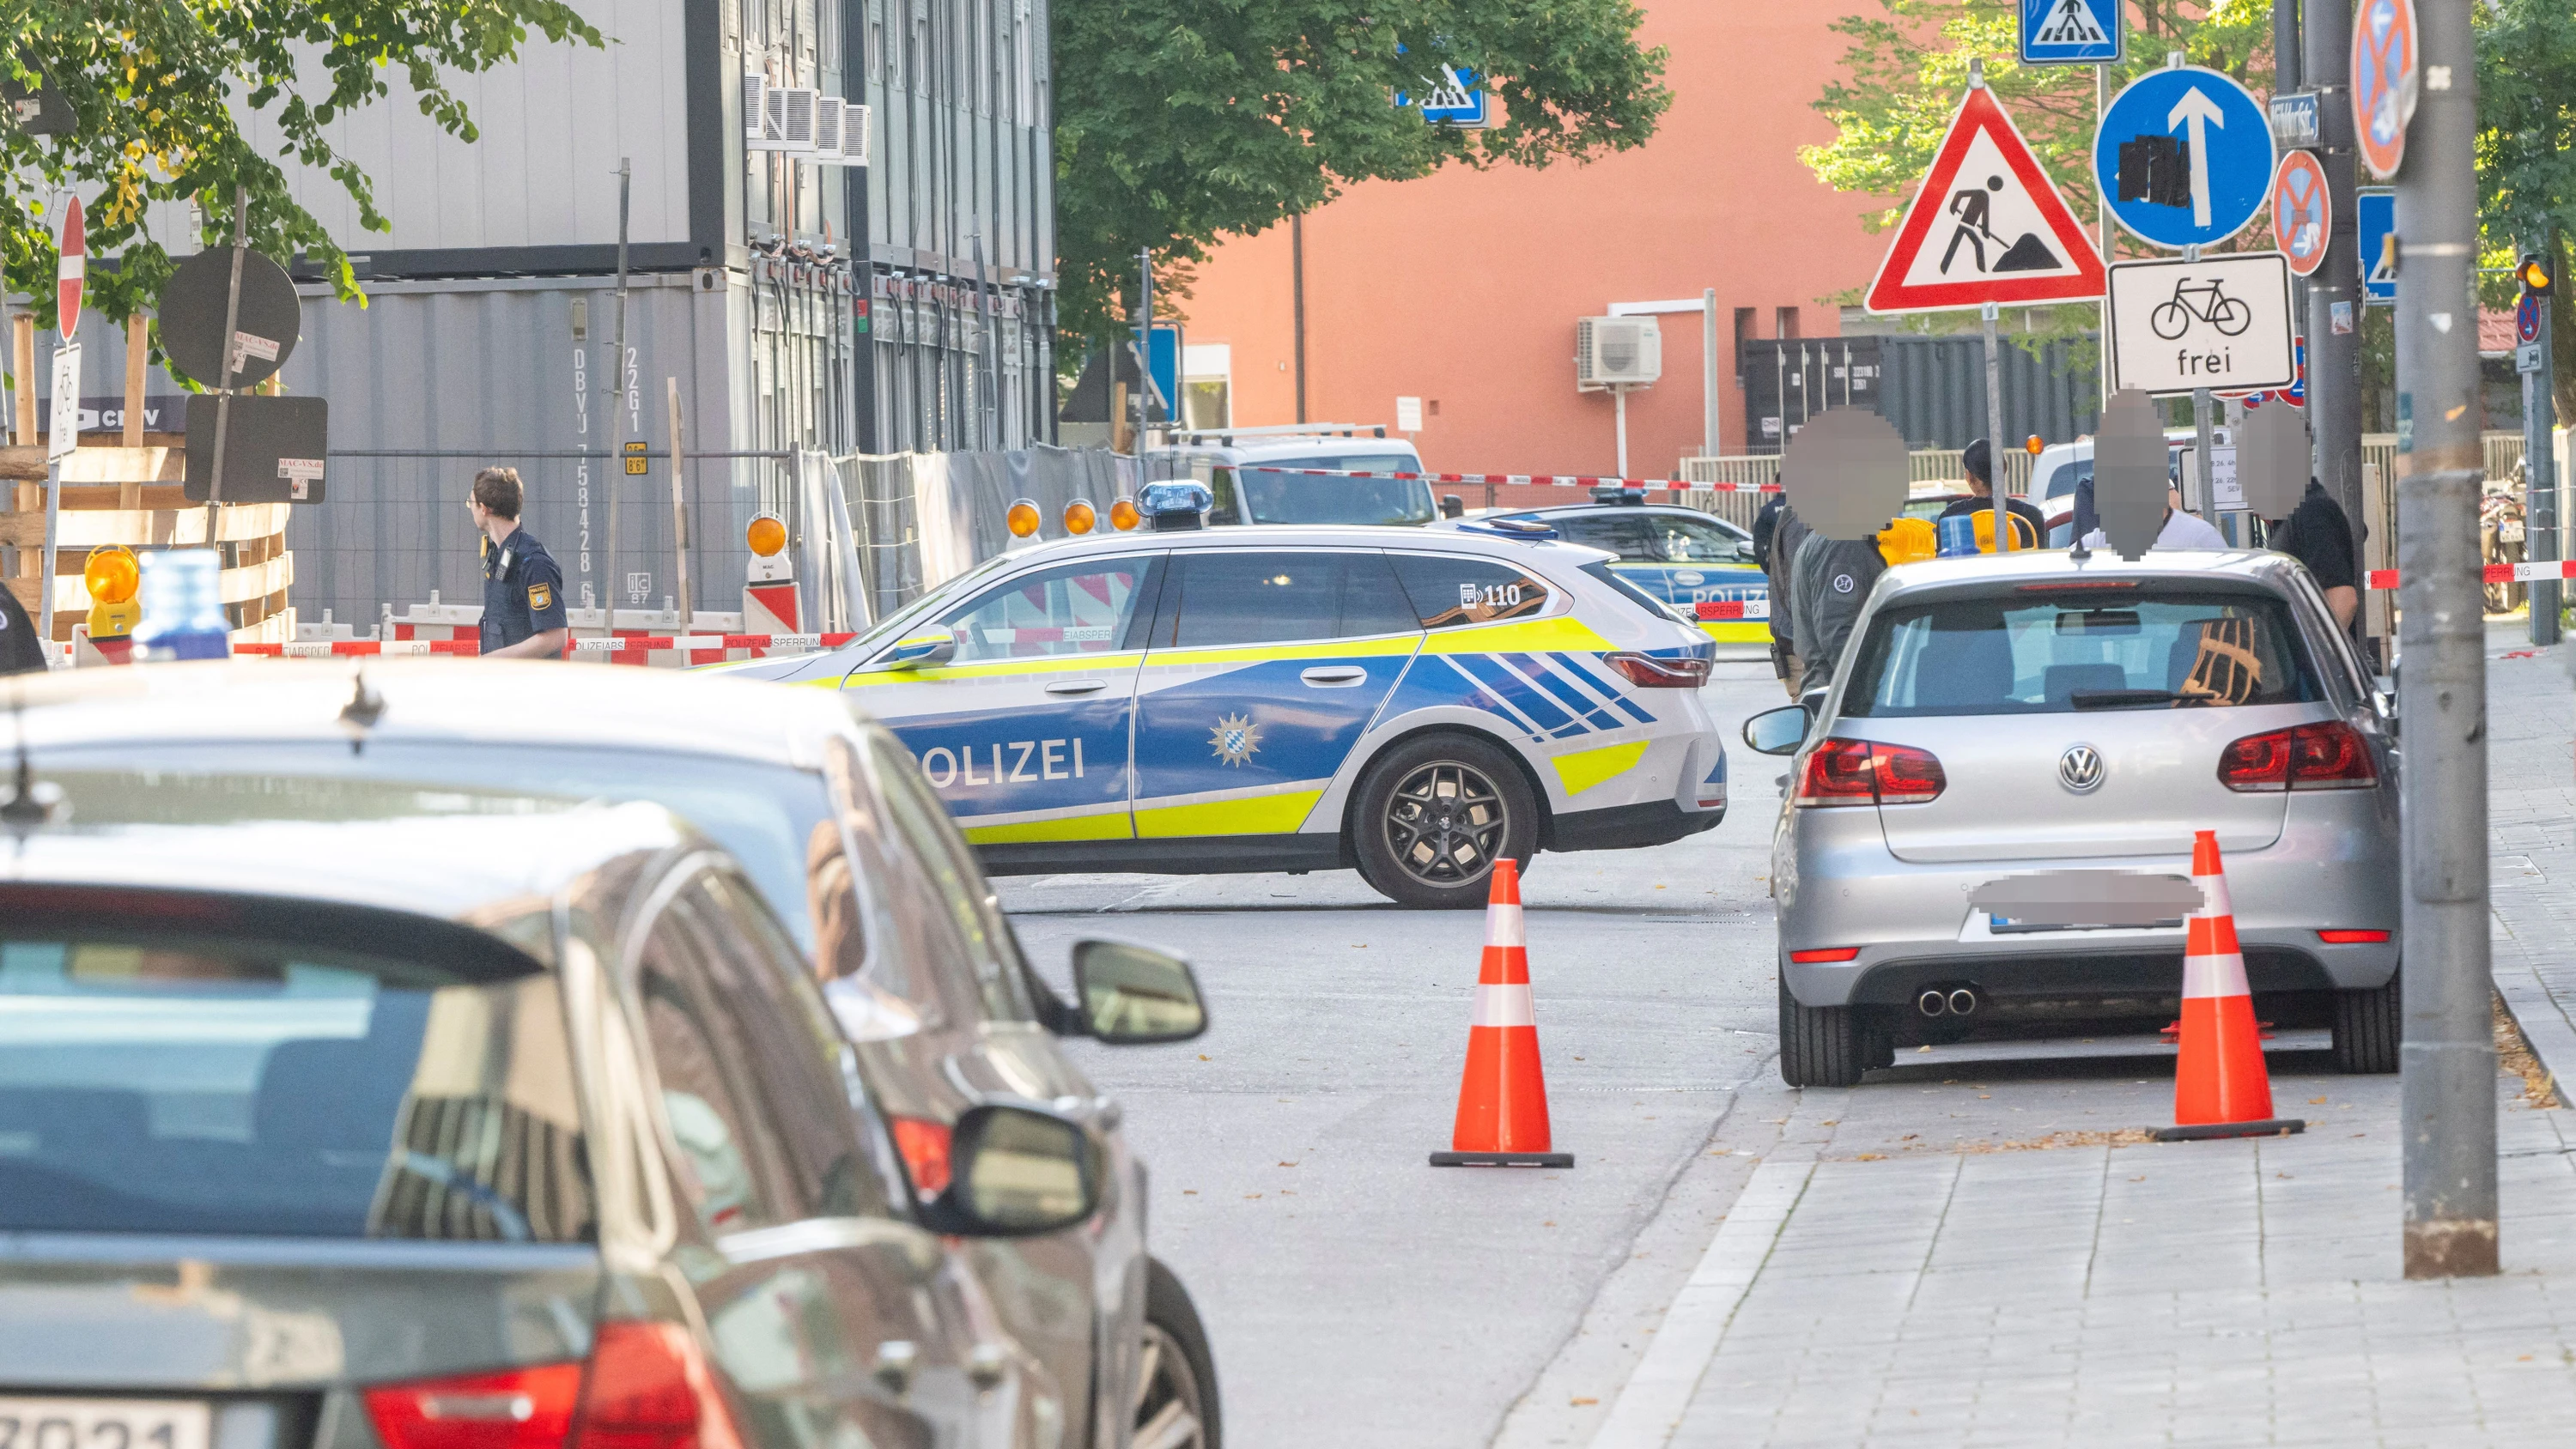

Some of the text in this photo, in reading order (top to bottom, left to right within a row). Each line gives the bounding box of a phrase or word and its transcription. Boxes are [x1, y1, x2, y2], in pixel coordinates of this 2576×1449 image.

[2178, 346, 2231, 375] frei
[574, 349, 587, 433] DBVU
[627, 348, 640, 433] 22G1
[279, 459, 323, 469] MAC-VS.de
[631, 593, 647, 603] 87
[1485, 585, 1520, 606] 110
[568, 640, 670, 651] POLIZEIABSPERRUNG
[725, 637, 826, 647] POLIZEIABSPERRUNG
[921, 737, 1084, 789] OLIZEI
